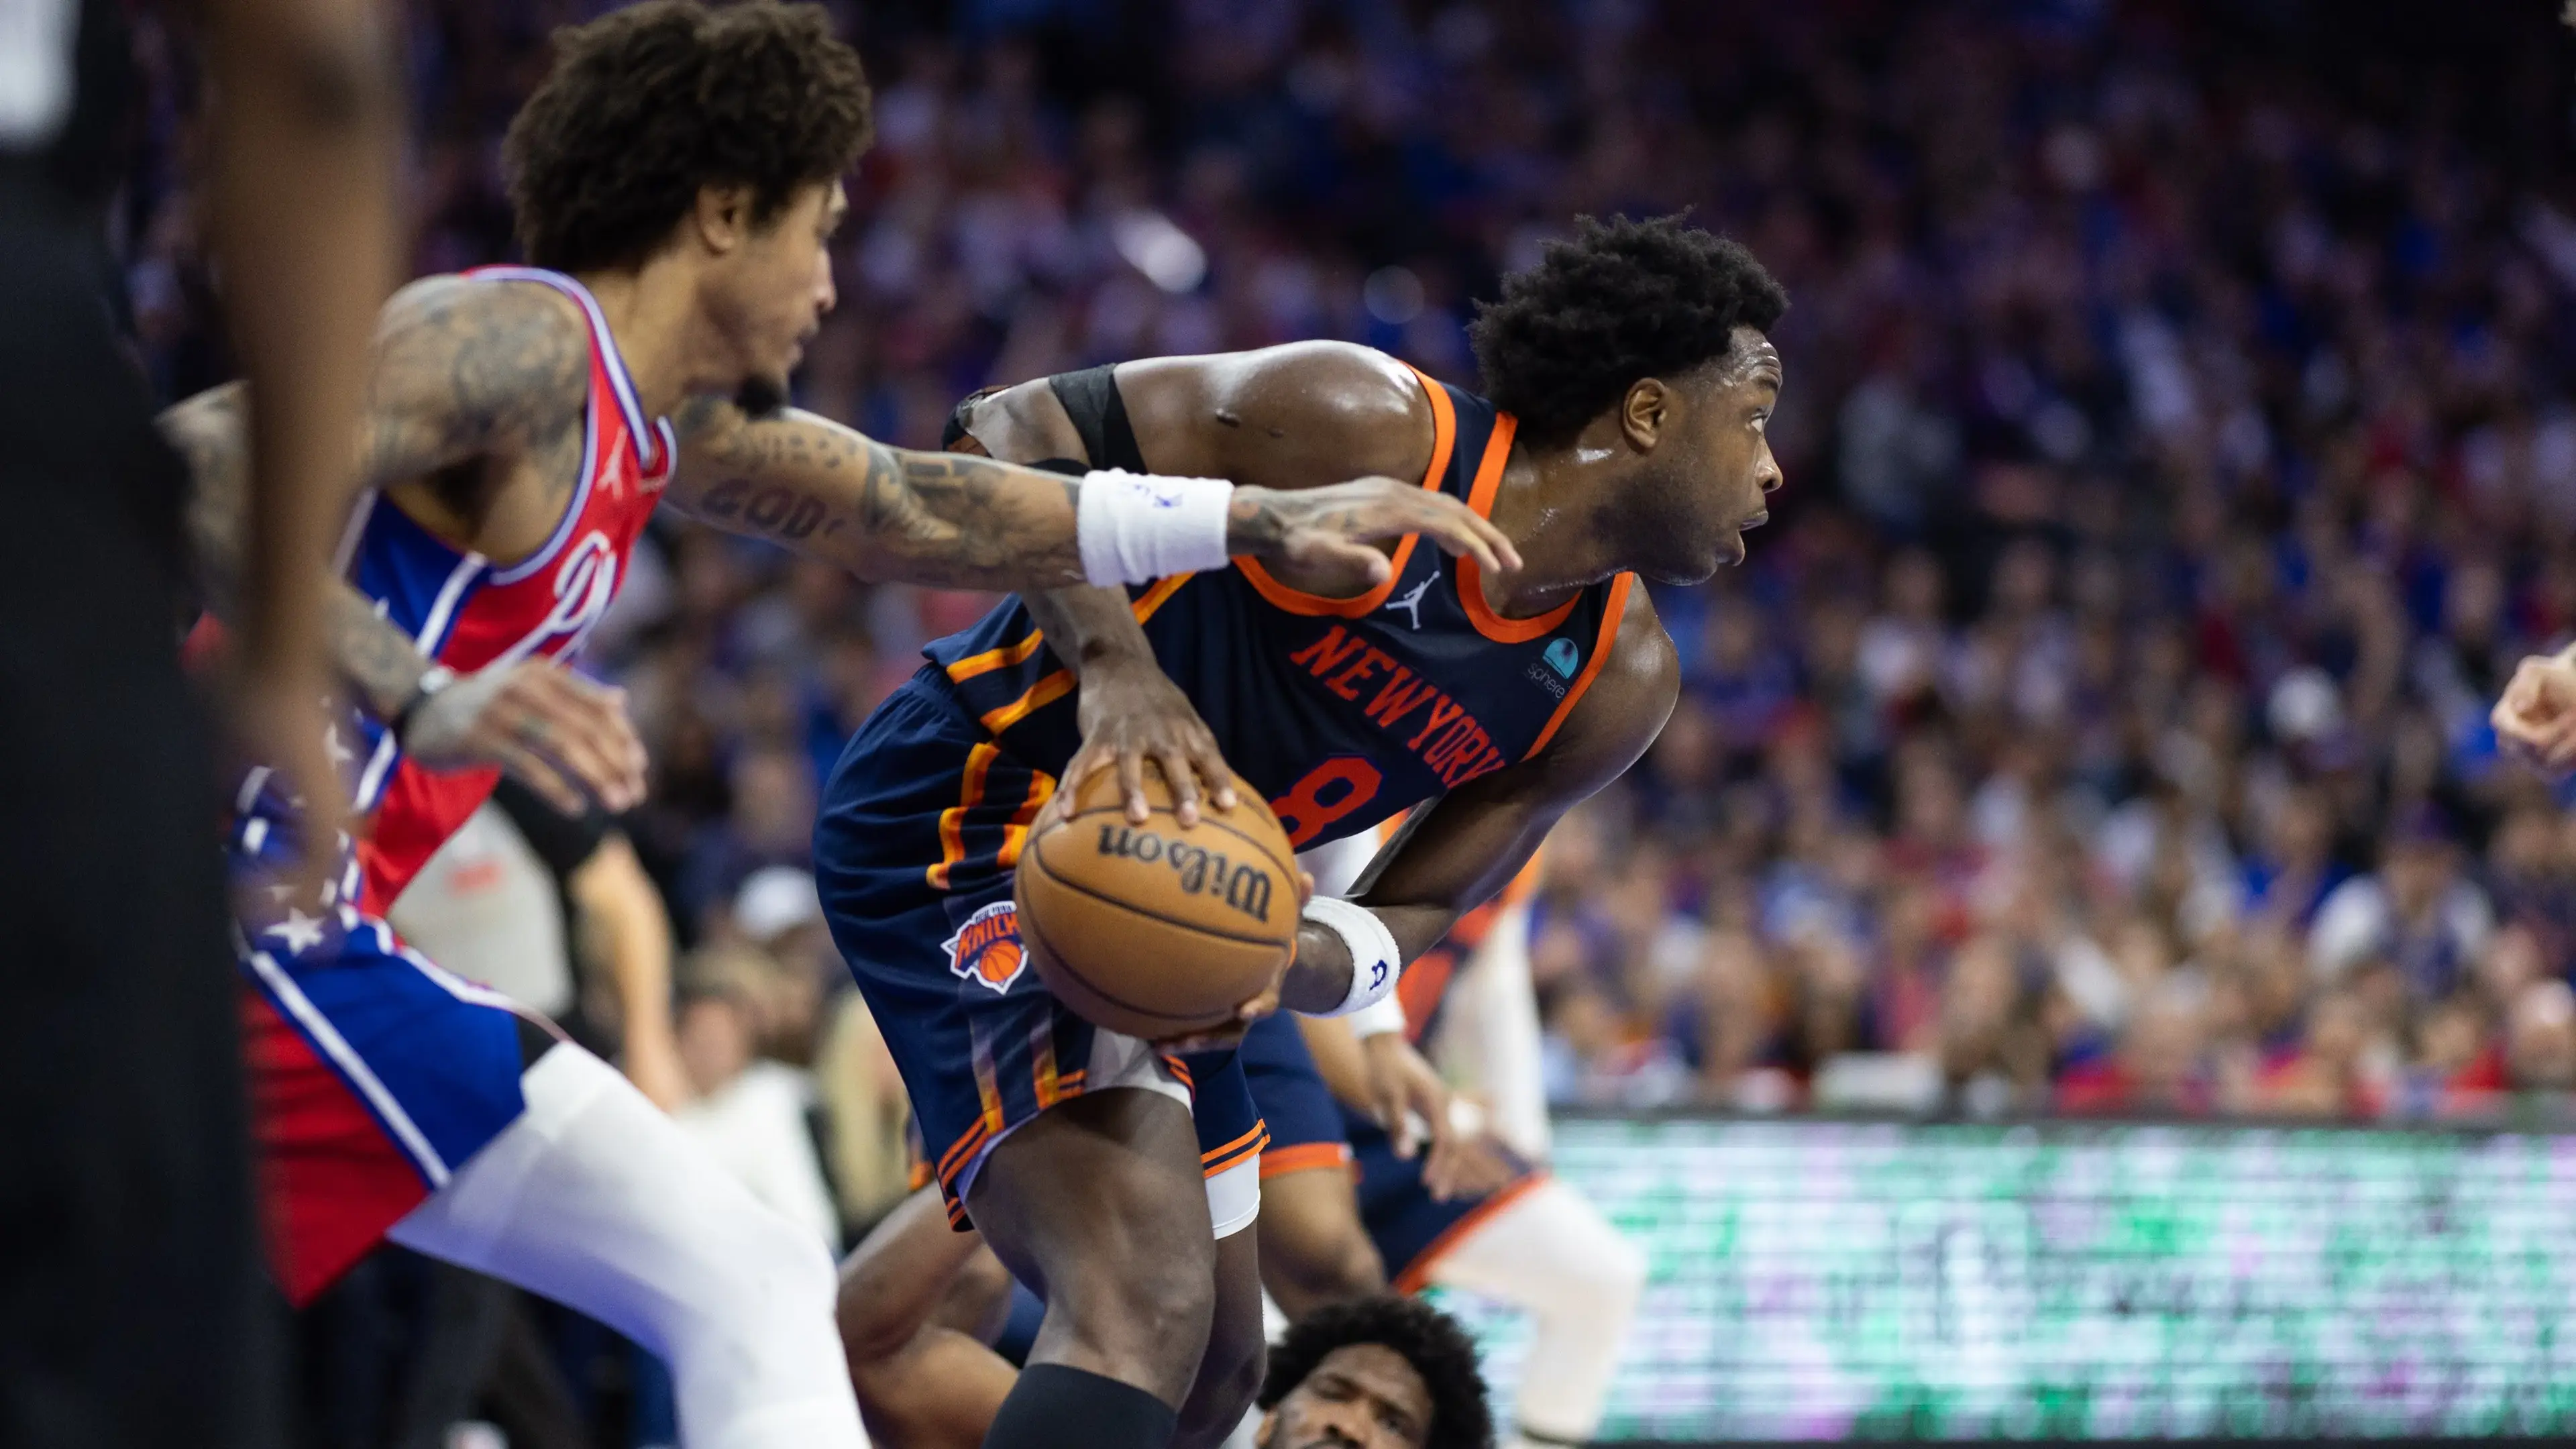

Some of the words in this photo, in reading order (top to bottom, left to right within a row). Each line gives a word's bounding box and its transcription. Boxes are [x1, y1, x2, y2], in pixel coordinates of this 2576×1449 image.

[1291, 625, 1438, 729] NEW
[1407, 693, 1505, 789] YORK
[1527, 662, 1565, 698] sphere
[1270, 757, 1382, 849] 8
[1098, 824, 1271, 923] Wilson
[954, 912, 1022, 969] KNICK
